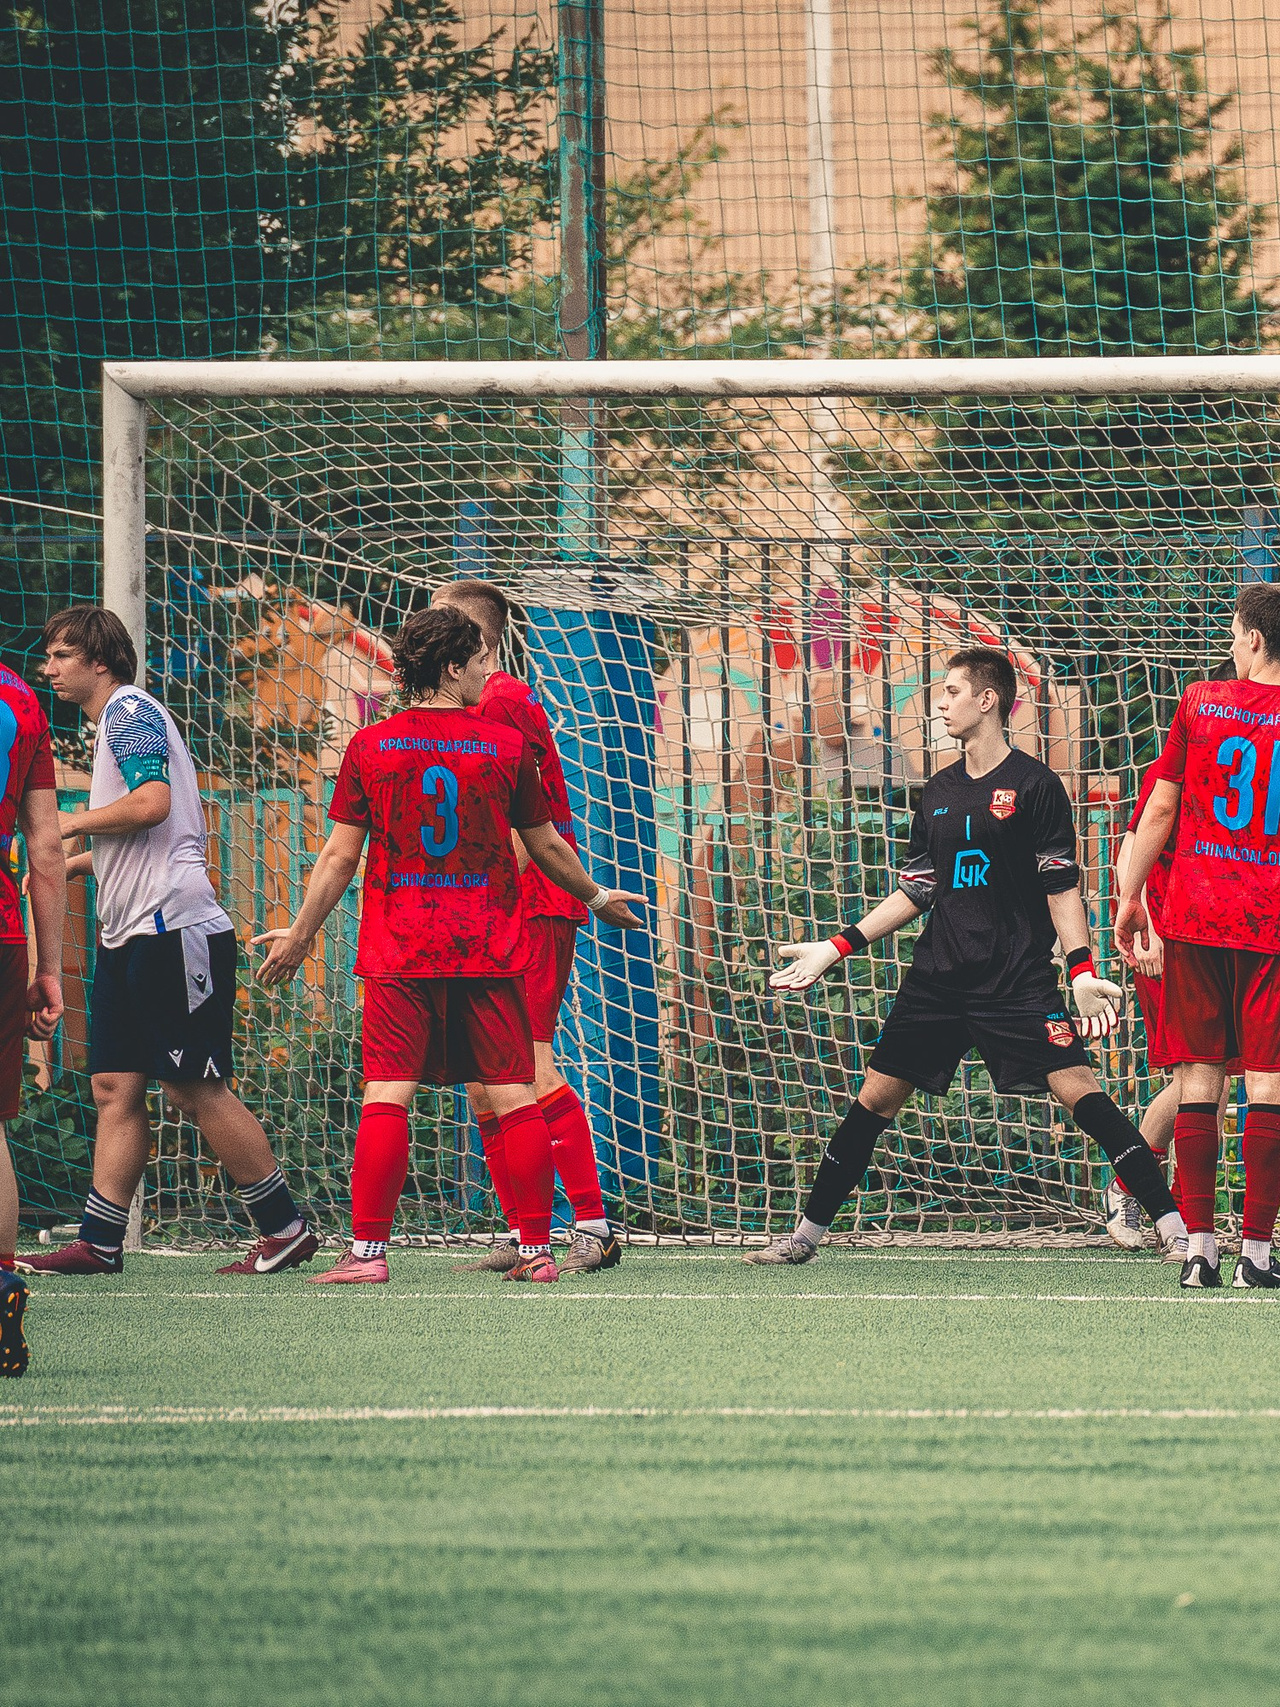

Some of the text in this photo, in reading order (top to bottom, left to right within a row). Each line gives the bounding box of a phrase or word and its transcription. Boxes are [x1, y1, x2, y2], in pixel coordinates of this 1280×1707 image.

[379, 736, 498, 758] КРАСНОГВАРДЕЕЦ
[420, 765, 459, 857] 3
[390, 872, 490, 889] CHINACOAL.ORG
